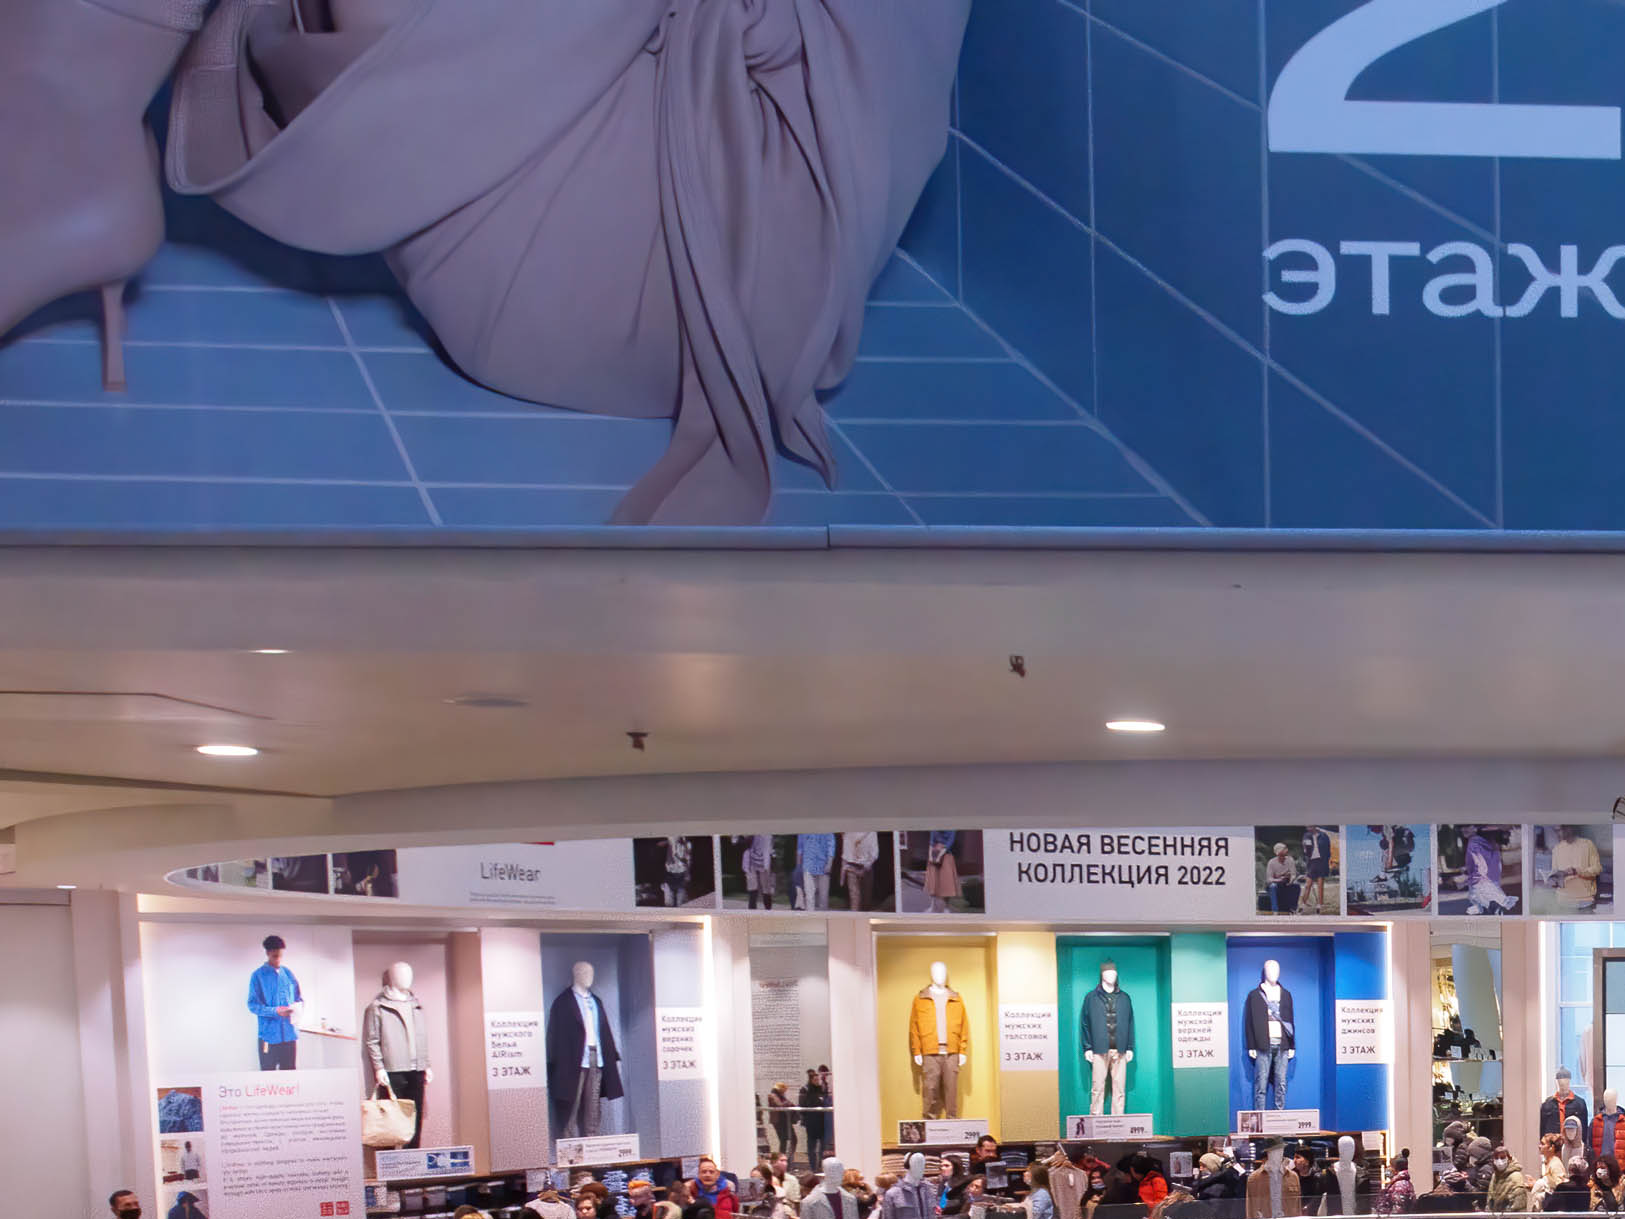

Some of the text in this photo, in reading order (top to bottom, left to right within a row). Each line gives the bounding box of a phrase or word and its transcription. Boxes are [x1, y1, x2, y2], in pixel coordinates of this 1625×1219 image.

[1009, 832, 1229, 857] НОВАЯ ВЕСЕННЯЯ
[480, 862, 541, 882] LifeWear
[1017, 862, 1226, 888] КОЛЛЕКЦИЯ 2022
[1005, 1011, 1051, 1019] Коллекция
[1177, 1009, 1222, 1018] Коллекция
[491, 1020, 539, 1028] Коллекция
[491, 1031, 532, 1039] мужского
[1177, 1027, 1212, 1035] верхней
[1177, 1035, 1211, 1043] одежды
[1178, 1050, 1214, 1058] 3 ЭТАЖ
[1342, 1046, 1376, 1054] 3 ЭТАЖ
[1005, 1051, 1043, 1060] 3 ЭТАЖ
[663, 1060, 697, 1070] 3 ЭТАЖ
[492, 1066, 532, 1077] 3 ЭТАЖ
[218, 1084, 300, 1098] Это LifeWear!
